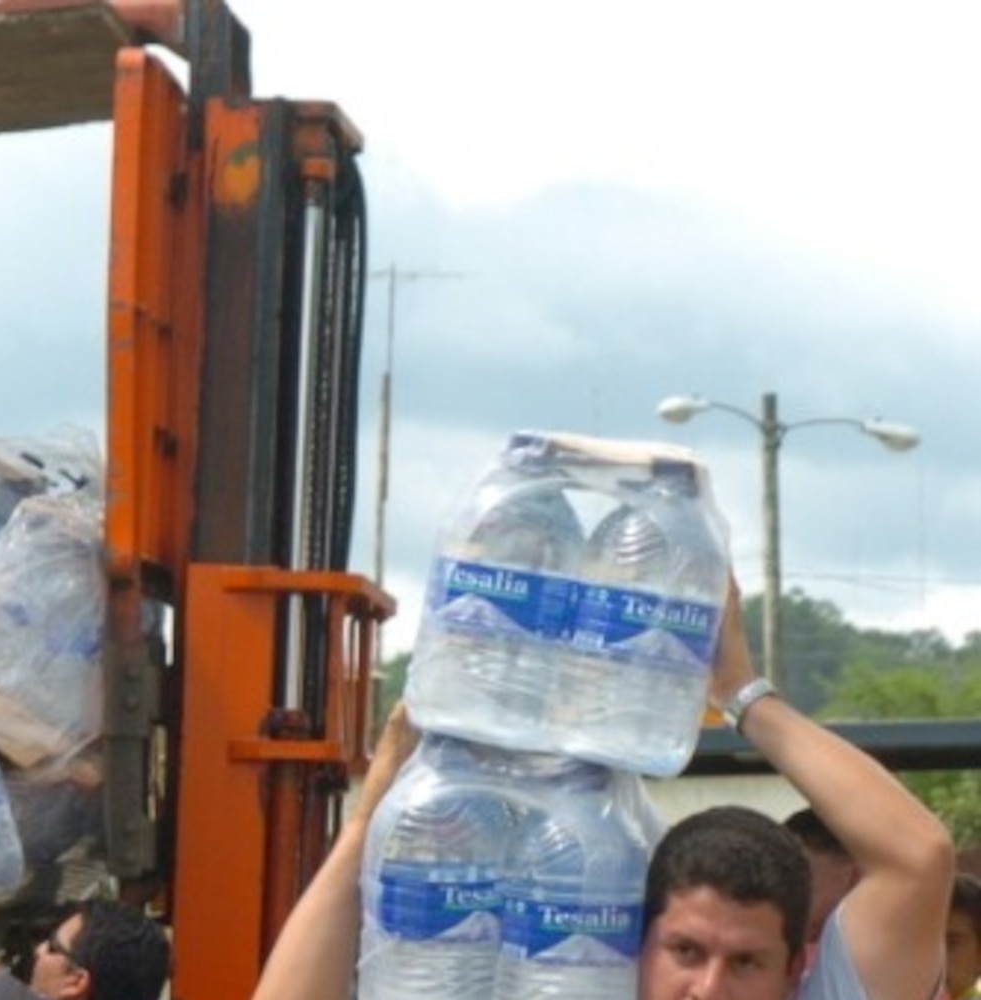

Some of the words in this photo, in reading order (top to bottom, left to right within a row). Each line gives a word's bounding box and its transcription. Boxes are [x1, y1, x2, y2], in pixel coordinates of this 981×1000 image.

[443, 561, 528, 595] Tesalia
[621, 594, 708, 627] Tesalia
[538, 904, 631, 928] Tesalia
